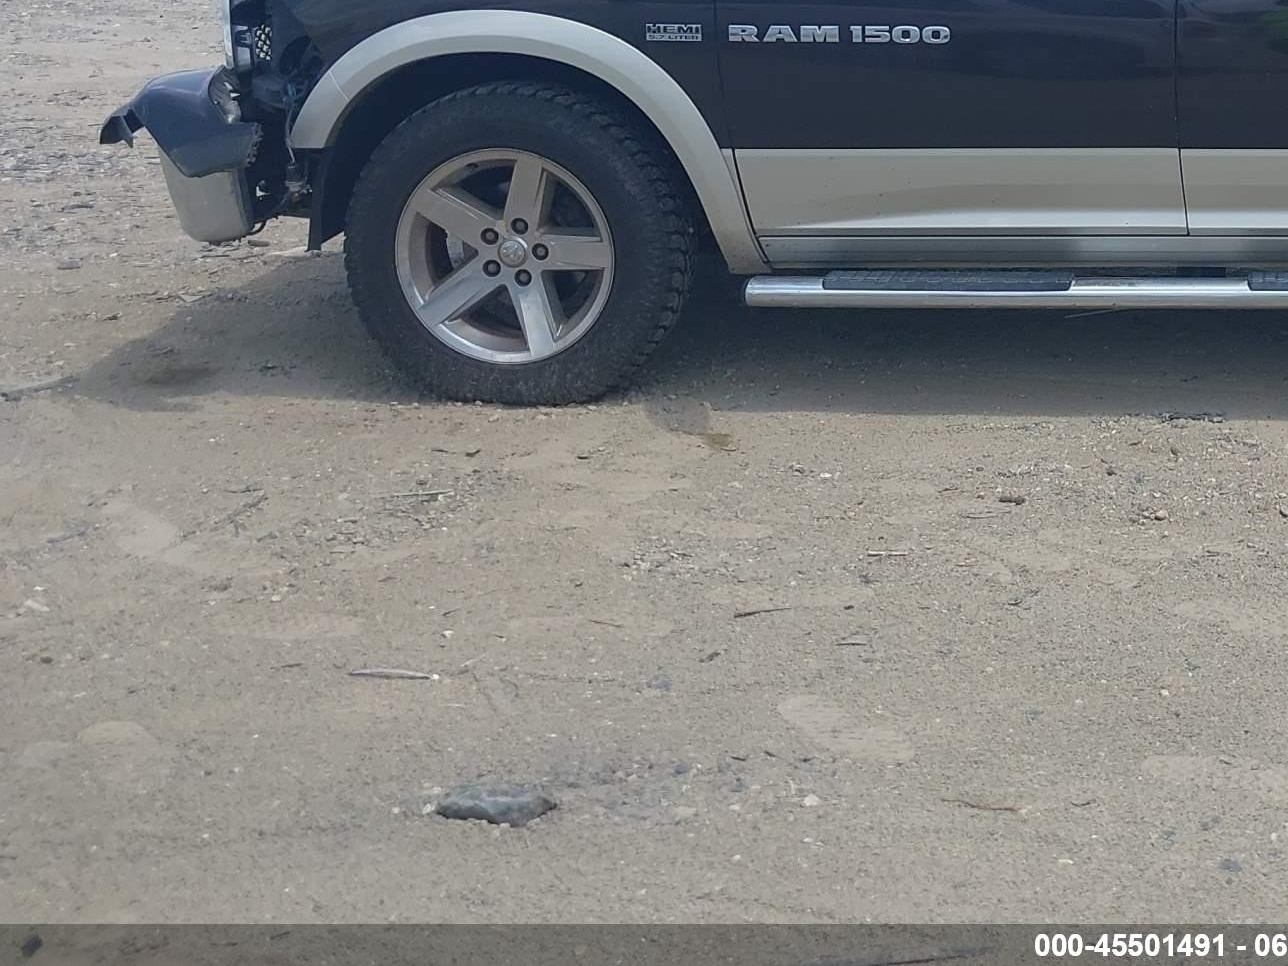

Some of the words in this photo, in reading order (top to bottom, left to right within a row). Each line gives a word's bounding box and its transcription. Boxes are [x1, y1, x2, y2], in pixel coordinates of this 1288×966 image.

[646, 24, 700, 34] HEMI
[728, 24, 840, 43] RAM
[849, 25, 951, 44] 1500
